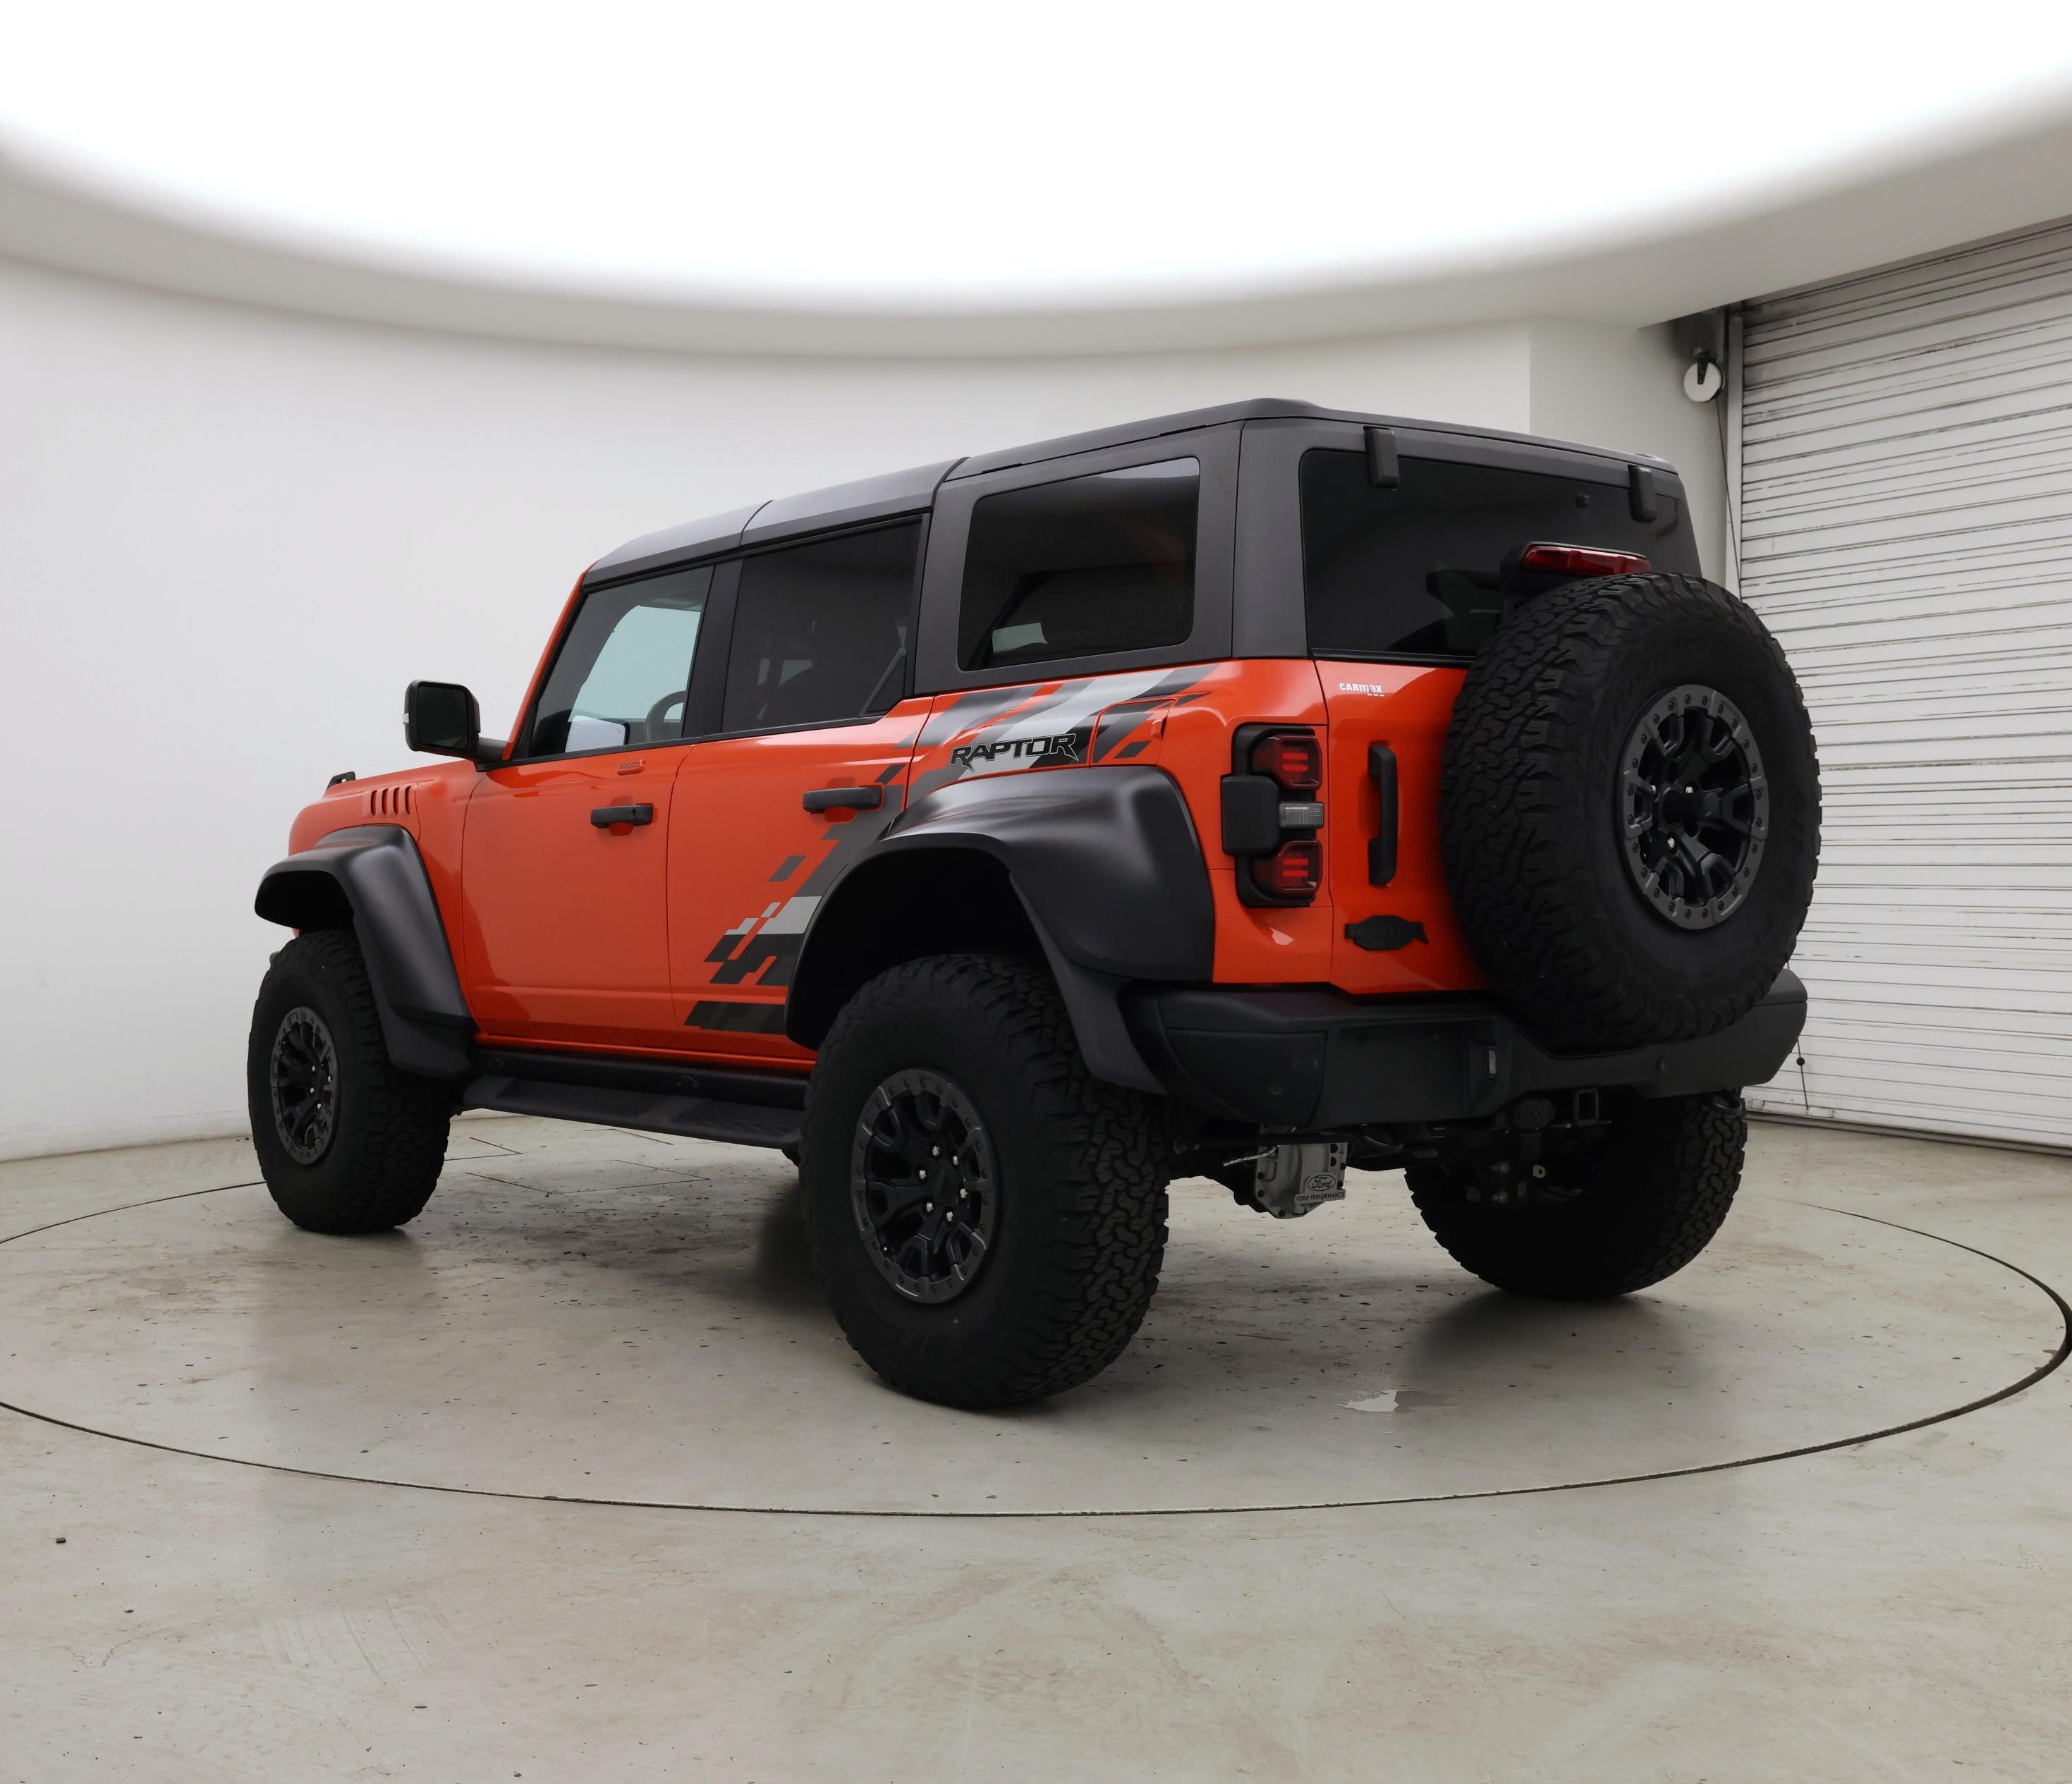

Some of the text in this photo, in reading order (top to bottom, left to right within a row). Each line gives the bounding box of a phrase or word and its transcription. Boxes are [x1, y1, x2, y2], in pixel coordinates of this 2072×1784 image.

[949, 733, 1079, 773] RAPTOR
[1311, 1176, 1333, 1189] Ford
[1310, 1191, 1344, 1199] PERFORMANCE
